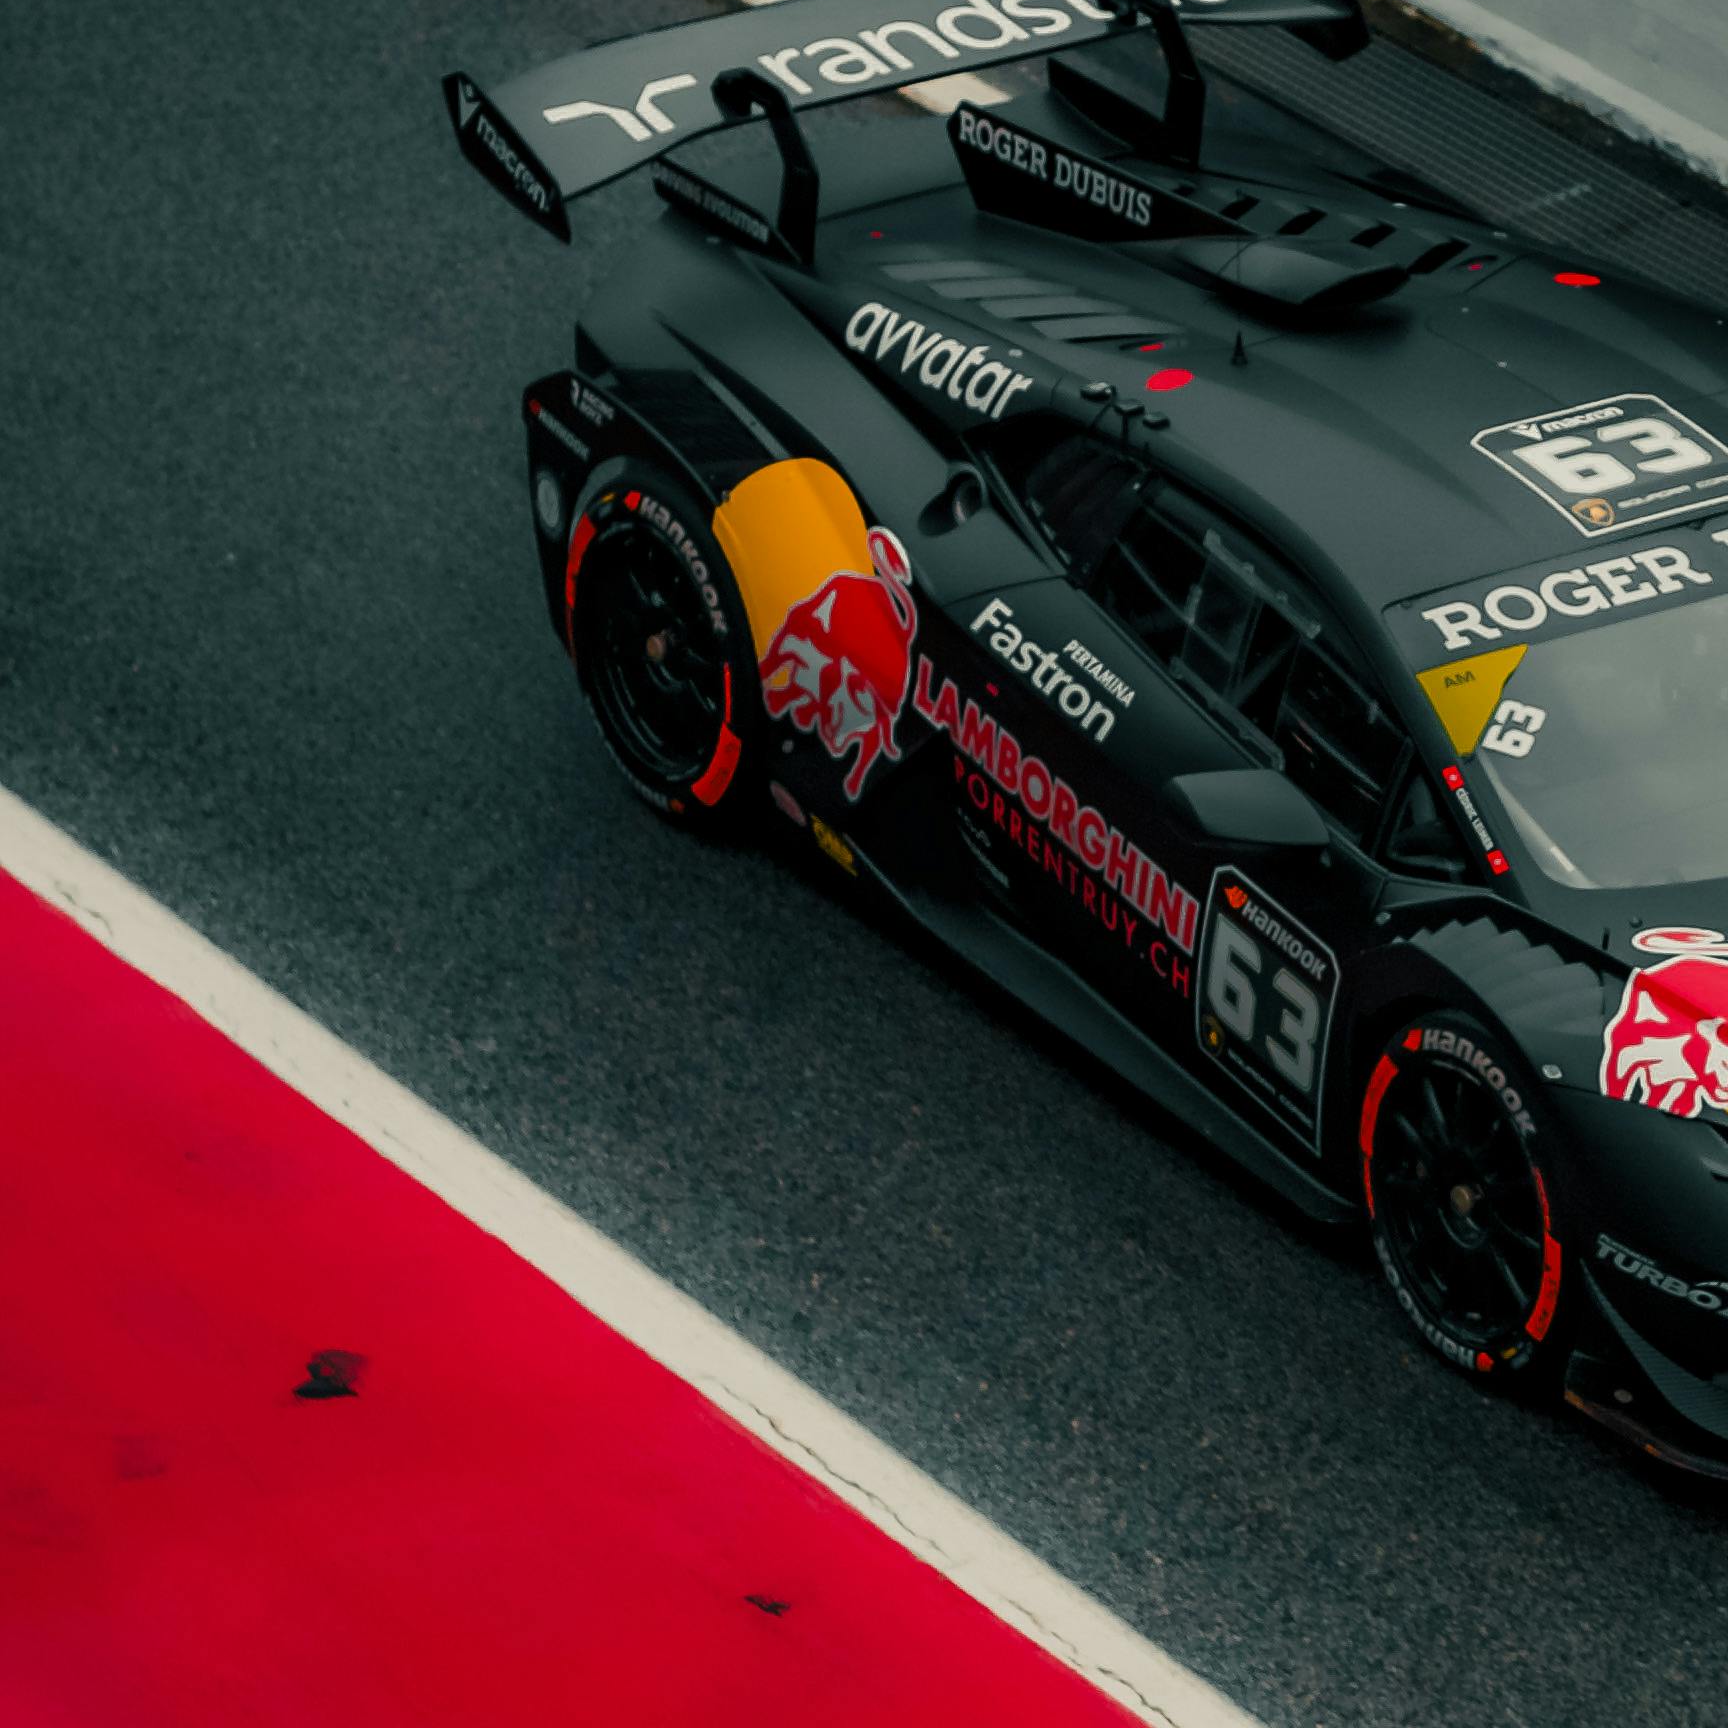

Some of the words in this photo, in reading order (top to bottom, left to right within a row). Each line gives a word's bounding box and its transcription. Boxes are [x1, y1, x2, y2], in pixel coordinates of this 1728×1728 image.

[958, 108, 1049, 182] ROGER
[1053, 151, 1153, 228] DUBUIS
[844, 301, 1034, 420] avvatar
[1511, 417, 1713, 494] 63
[1421, 545, 1713, 651] ROGER
[968, 596, 1116, 744] Fastron
[1062, 638, 1136, 709] PERTAMINA
[1443, 670, 1477, 689] AM
[1482, 699, 1547, 759] 63
[911, 653, 1200, 959] LAMBORGHINI
[1207, 911, 1321, 1094] 63
[1596, 1238, 1722, 1311] TURBO
